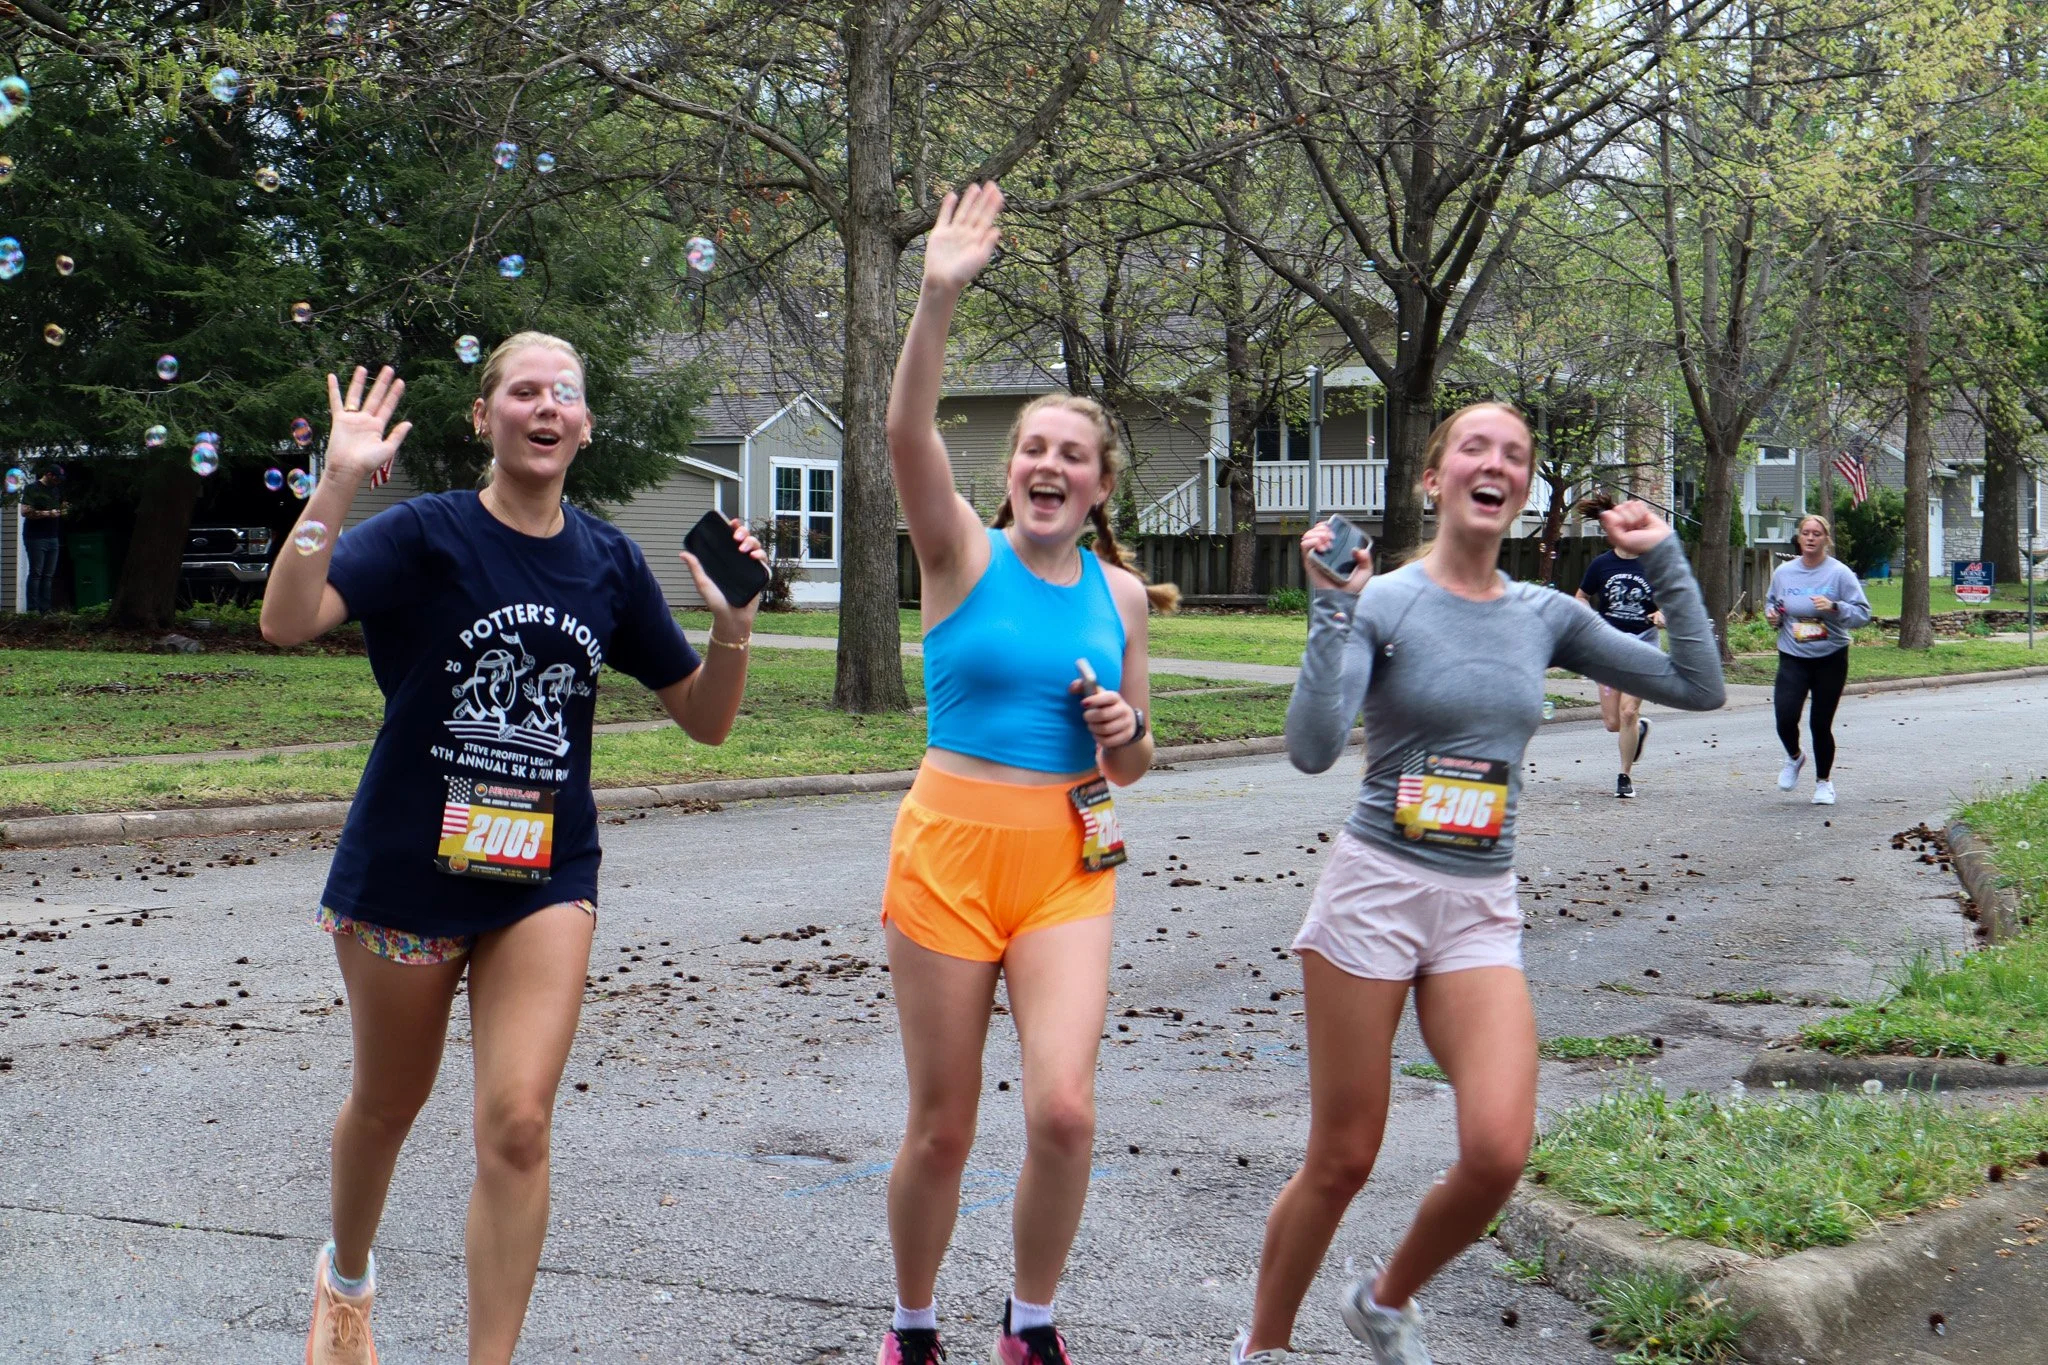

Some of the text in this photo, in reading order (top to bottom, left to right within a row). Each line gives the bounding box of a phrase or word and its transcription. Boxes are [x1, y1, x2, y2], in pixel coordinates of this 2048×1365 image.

[459, 603, 603, 676] POTTER'S HOUSE
[444, 659, 463, 674] 20
[429, 745, 454, 762] 4TH
[456, 752, 508, 774] ANNUAL
[511, 763, 527, 777] 5K
[529, 768, 537, 779] &
[537, 769, 554, 781] FUN
[464, 742, 489, 756] STEVE
[491, 748, 529, 763] PROFFITT
[1418, 784, 1496, 829] 2306
[463, 813, 545, 860] 2003
